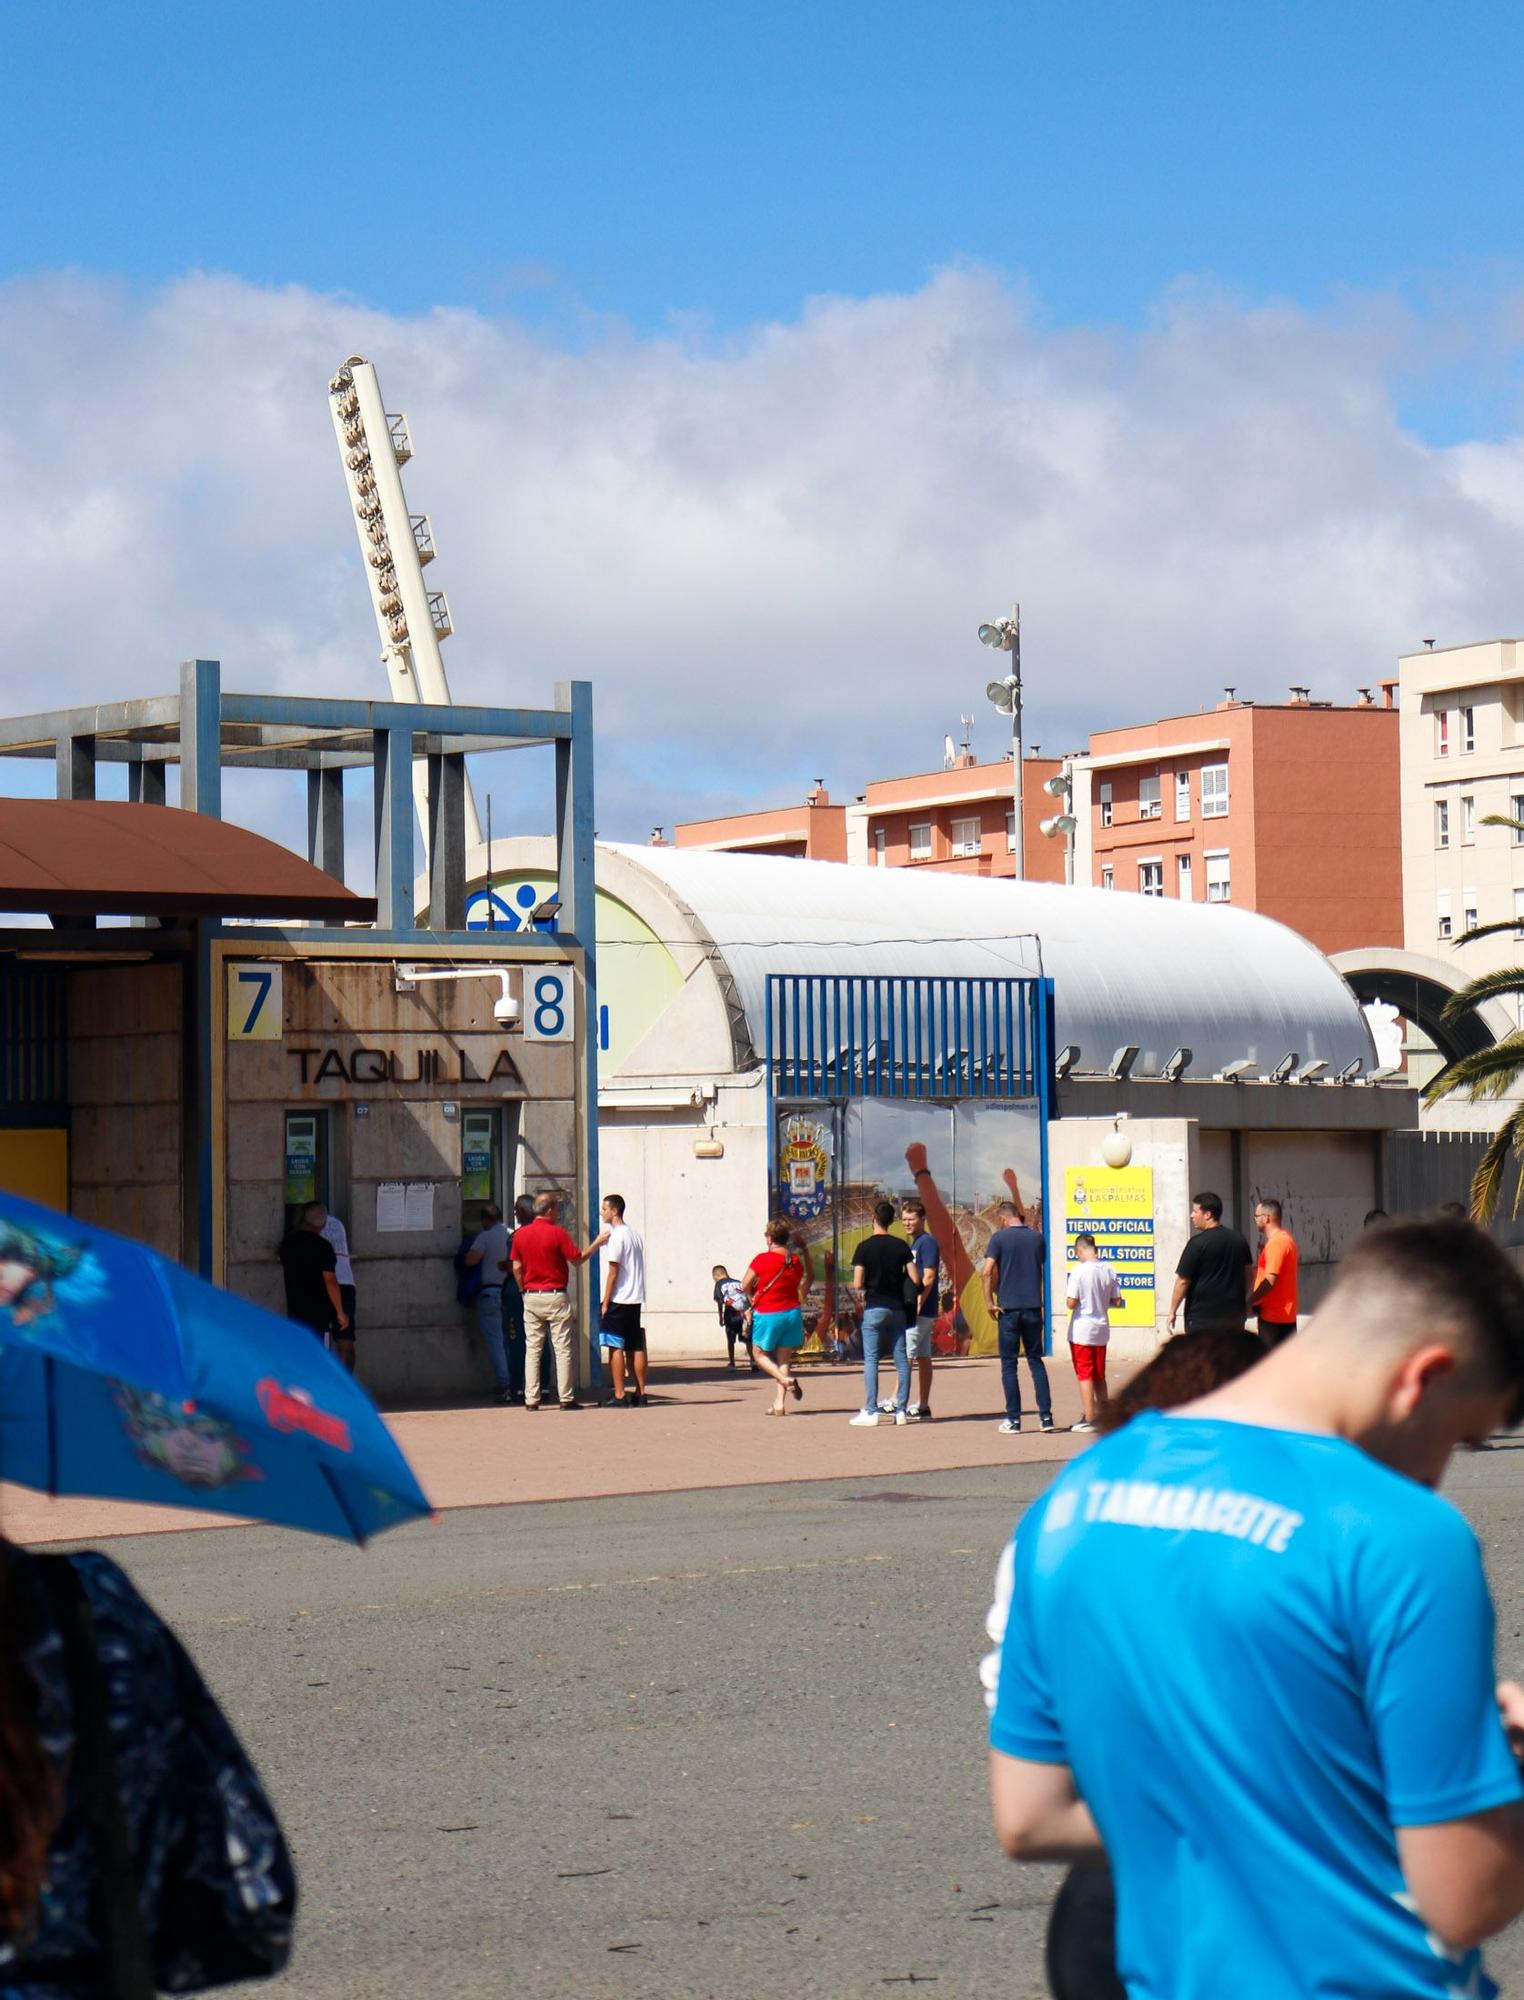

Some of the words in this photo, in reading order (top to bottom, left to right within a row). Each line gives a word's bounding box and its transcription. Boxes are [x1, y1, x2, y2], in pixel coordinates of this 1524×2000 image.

[238, 972, 272, 1034] 7
[533, 975, 565, 1036] 8
[287, 1049, 522, 1084] TAQUILLA
[1067, 1221, 1106, 1232] TIENDA
[1109, 1221, 1152, 1232] OFICIAL
[1067, 1248, 1116, 1259] OIAL
[1117, 1249, 1153, 1260] STORE
[1123, 1277, 1154, 1287] STORE
